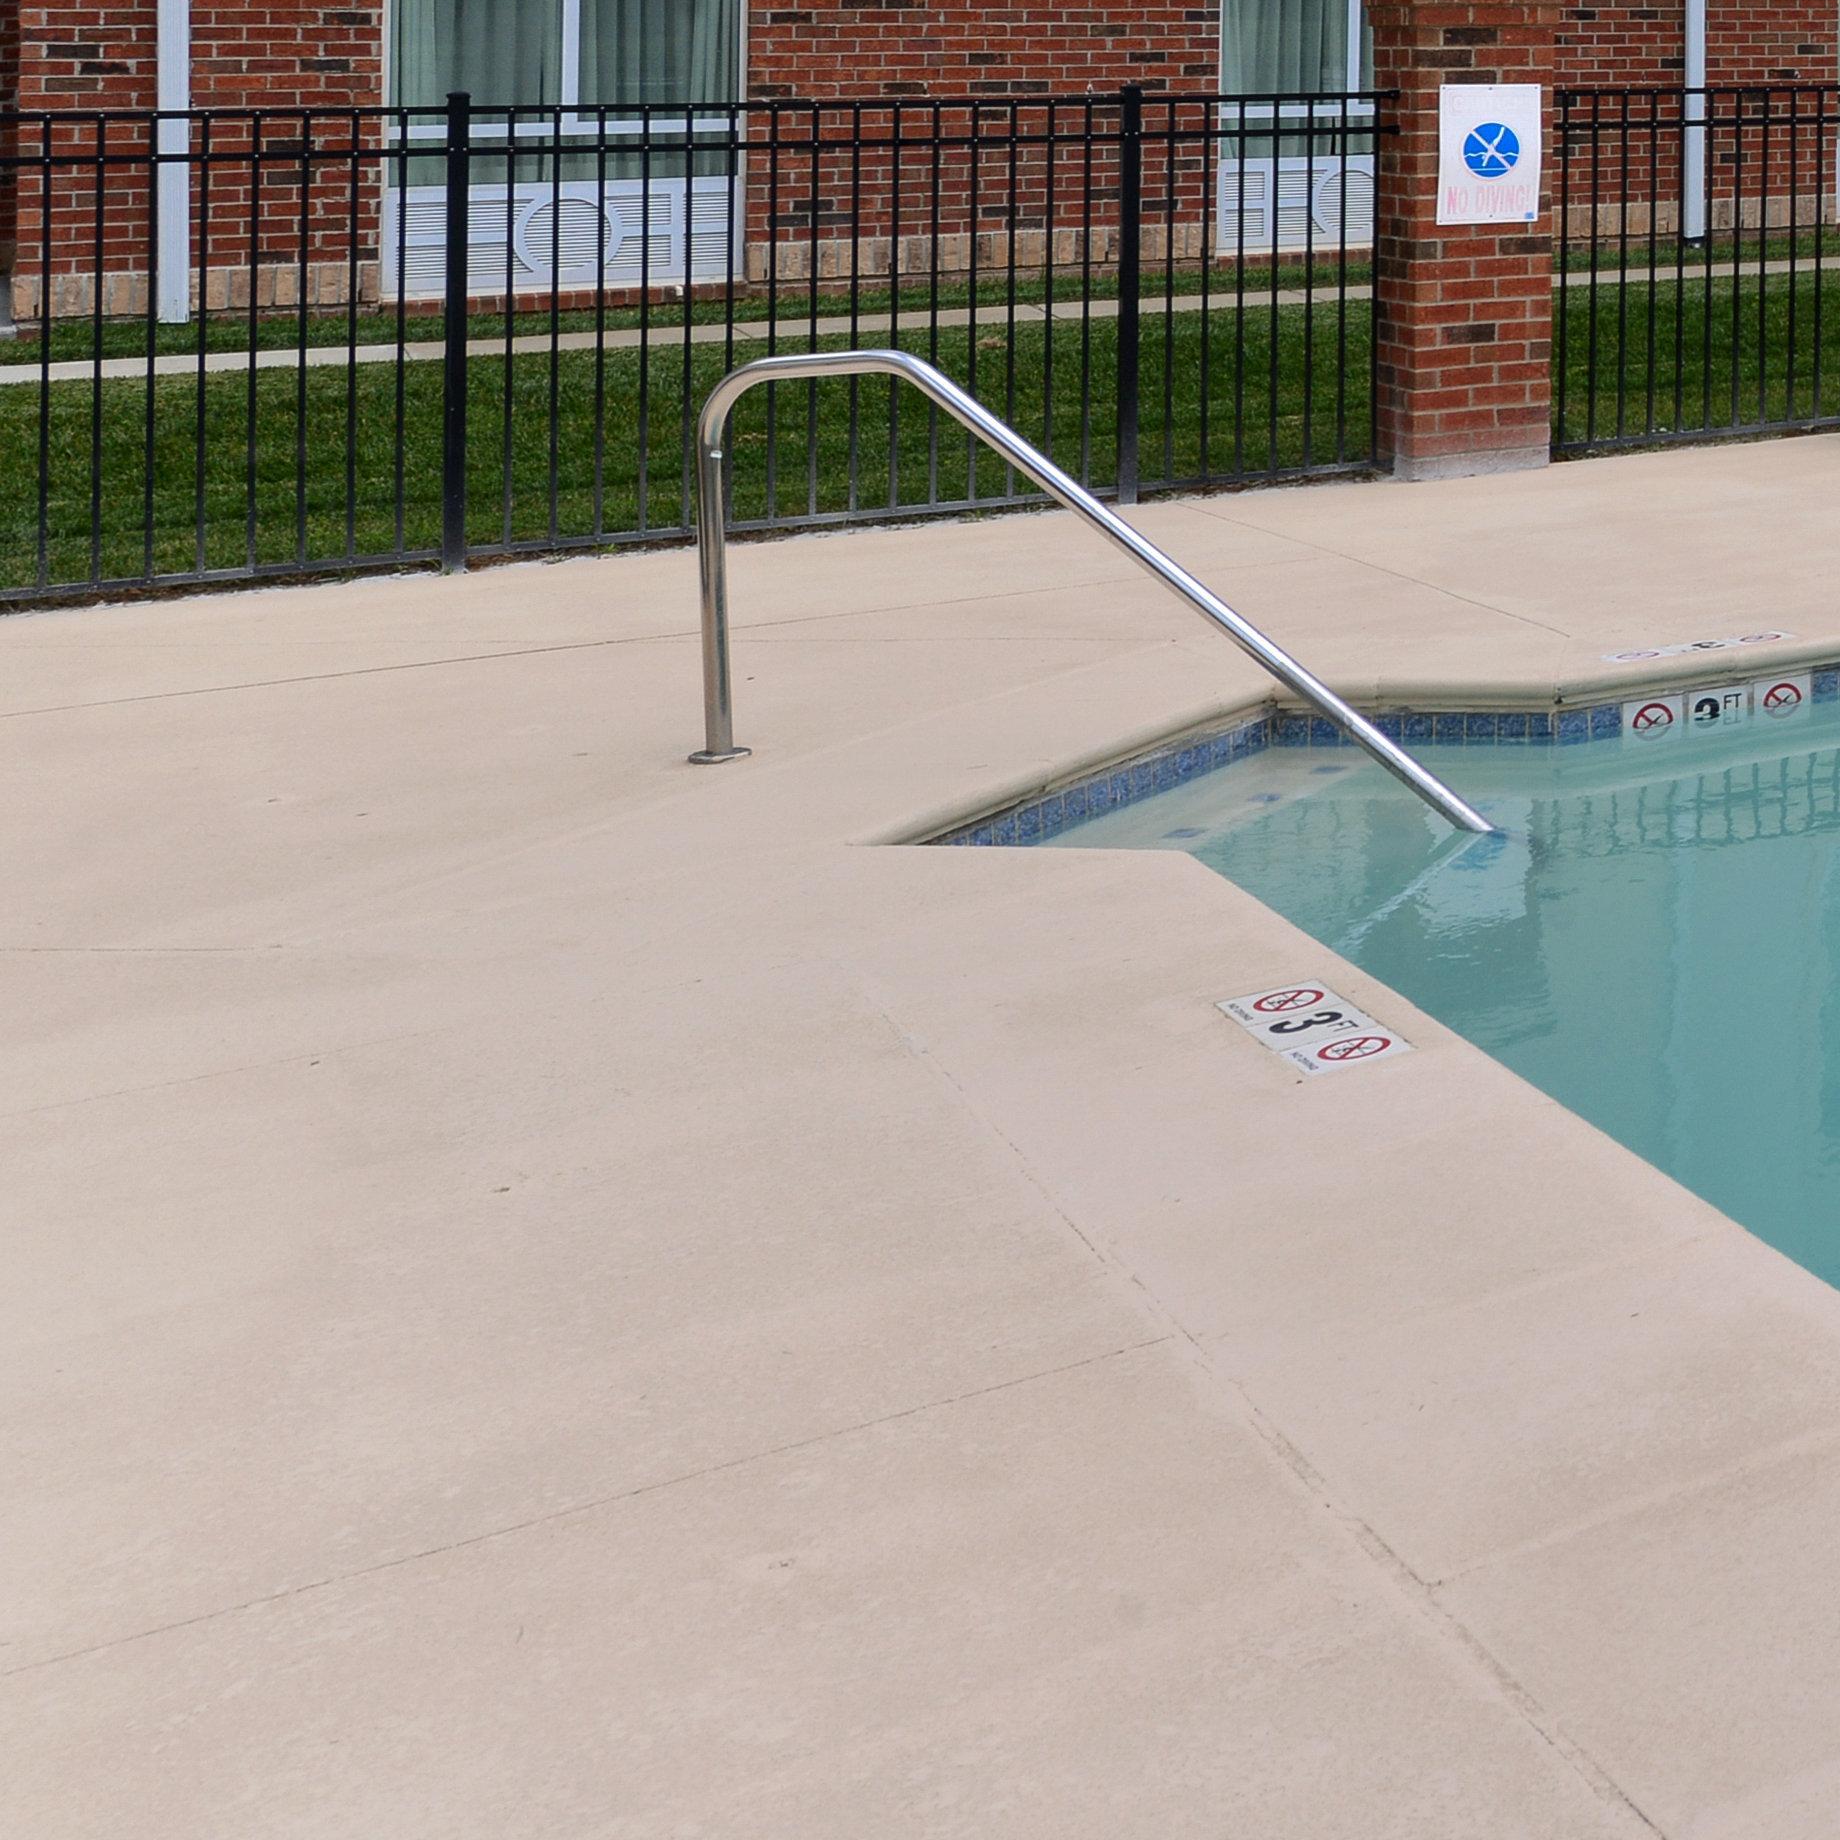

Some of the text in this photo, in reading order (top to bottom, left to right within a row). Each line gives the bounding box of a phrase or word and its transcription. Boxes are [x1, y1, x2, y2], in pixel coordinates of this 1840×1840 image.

[1447, 187, 1468, 214] NO
[1723, 693, 1742, 710] FT
[1269, 1011, 1344, 1035] 3
